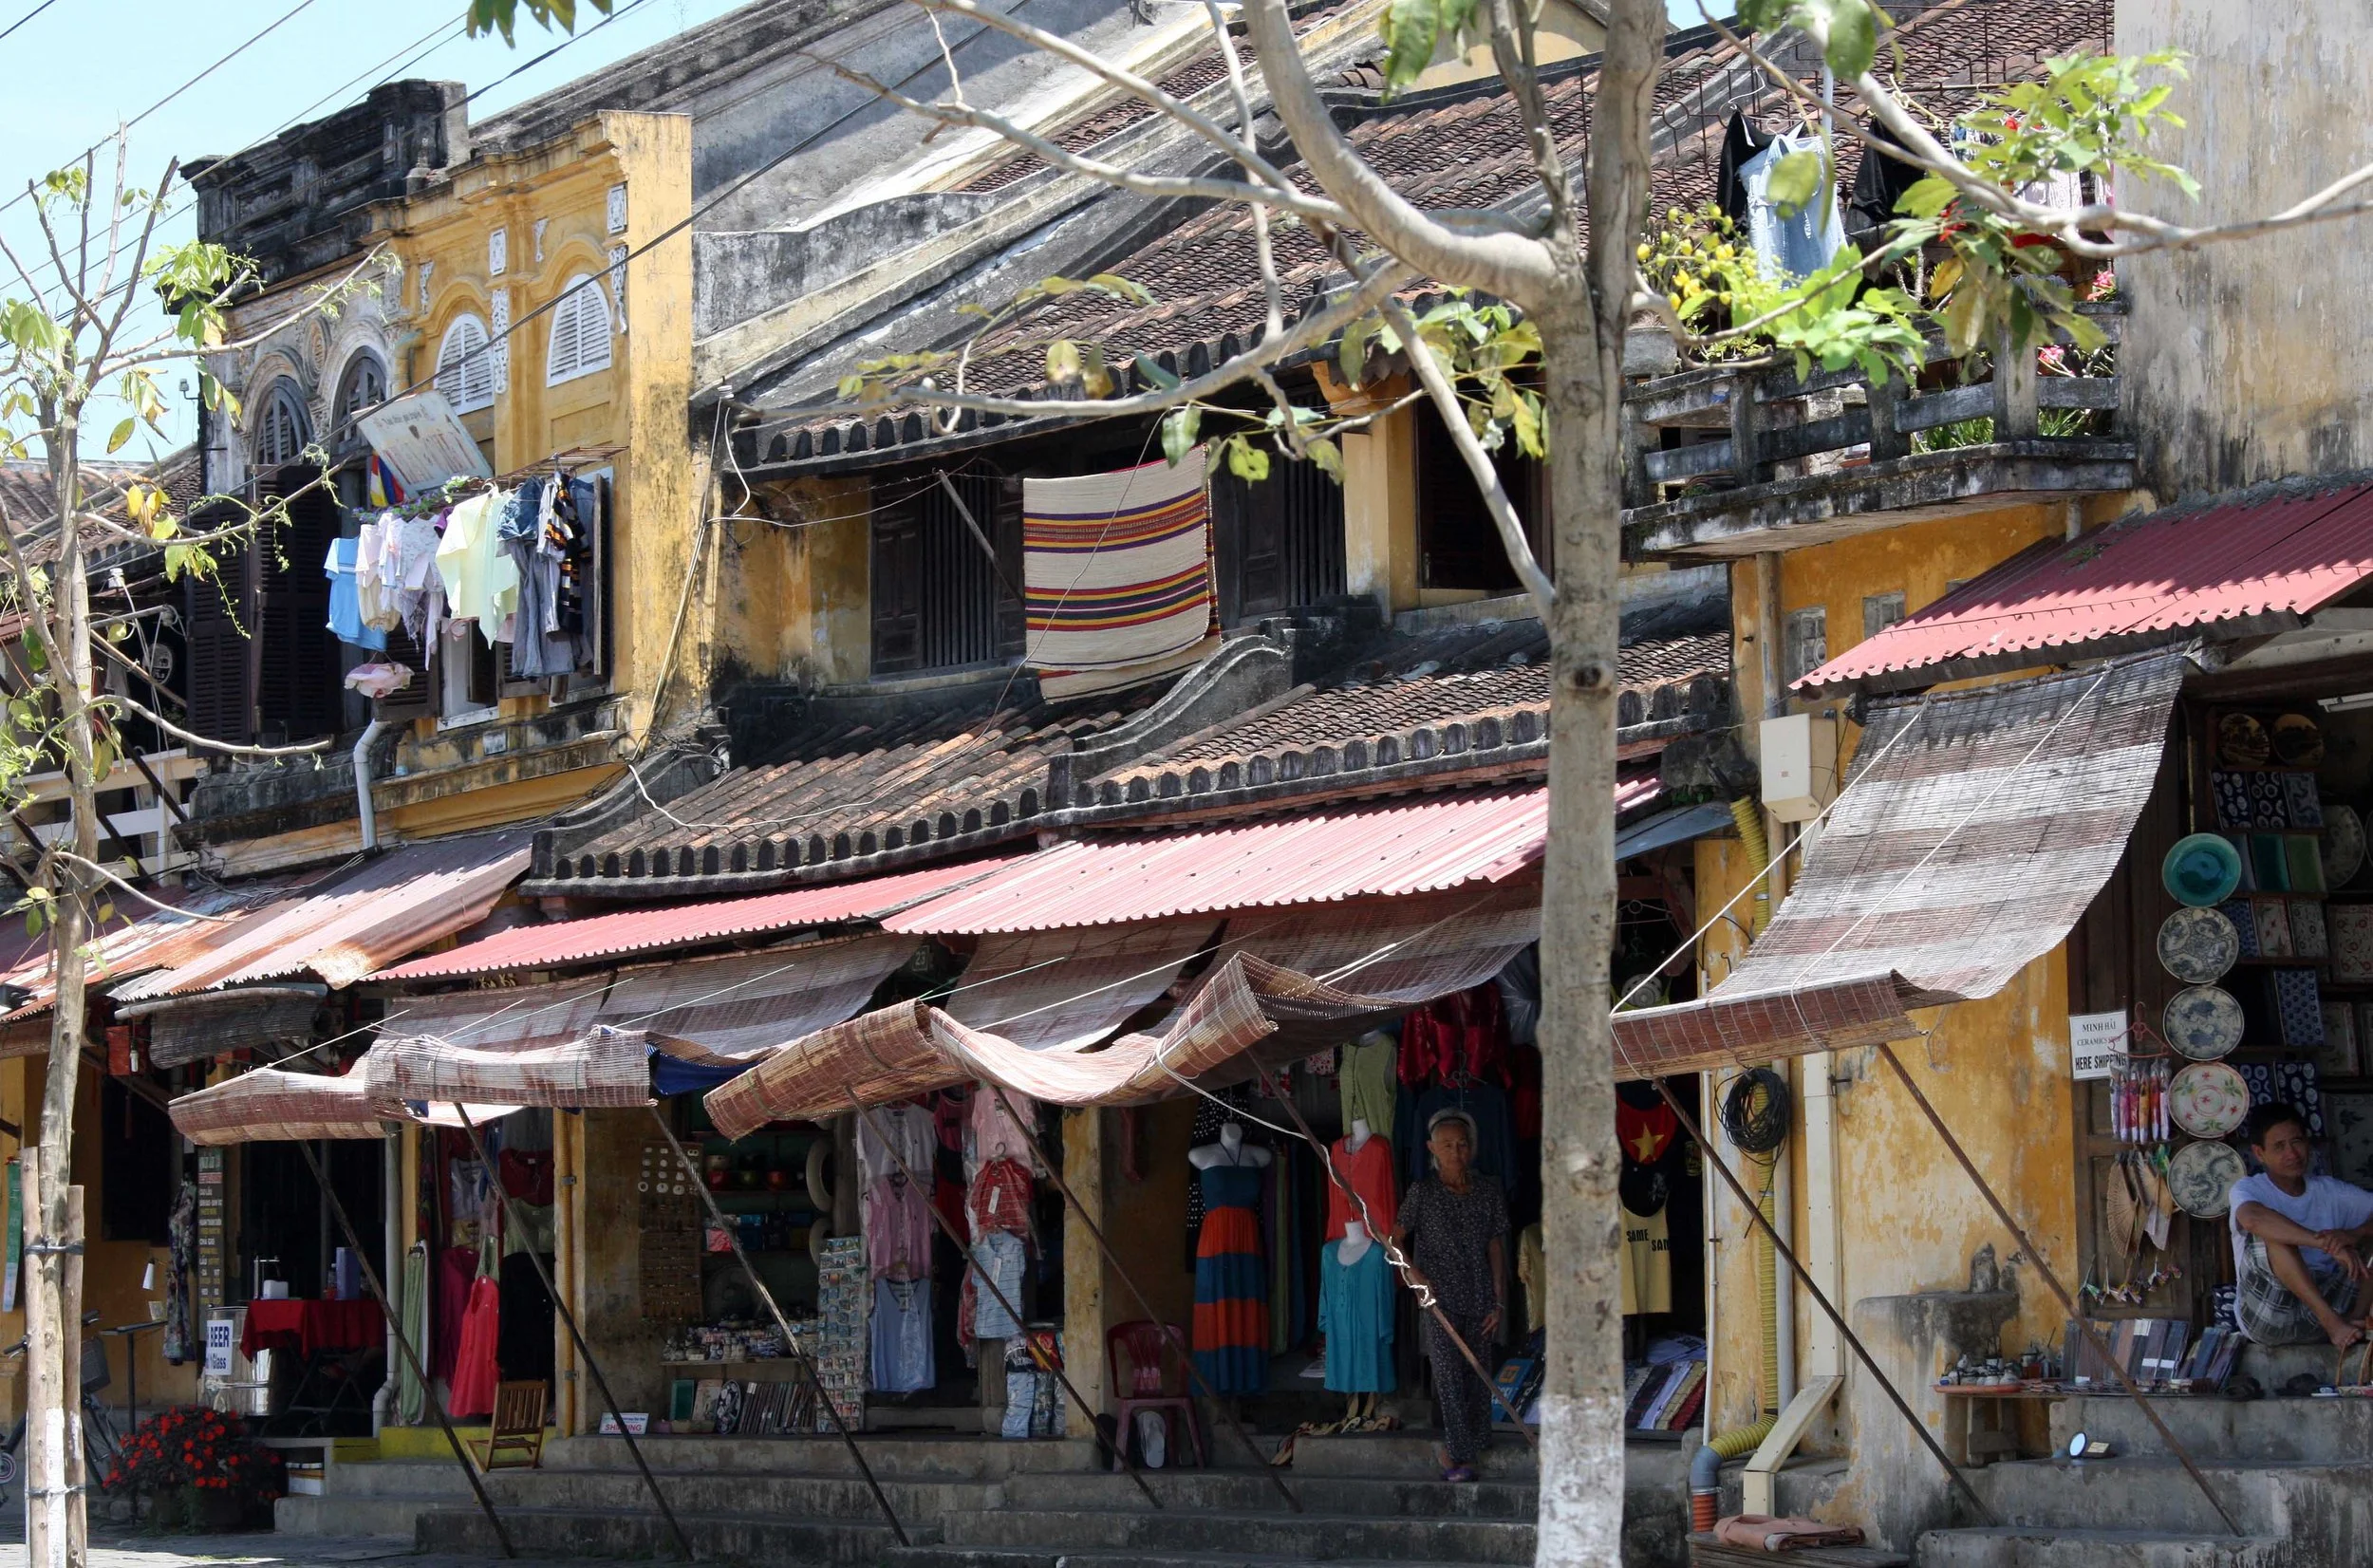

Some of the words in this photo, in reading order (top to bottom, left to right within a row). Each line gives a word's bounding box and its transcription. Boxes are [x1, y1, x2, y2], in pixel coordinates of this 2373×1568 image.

[2082, 1022, 2103, 1033] MINH
[2075, 1055, 2092, 1071] HERE
[1626, 1229, 1649, 1242] SAME
[1652, 1238, 1669, 1251] SAM
[210, 1326, 230, 1348] BEER
